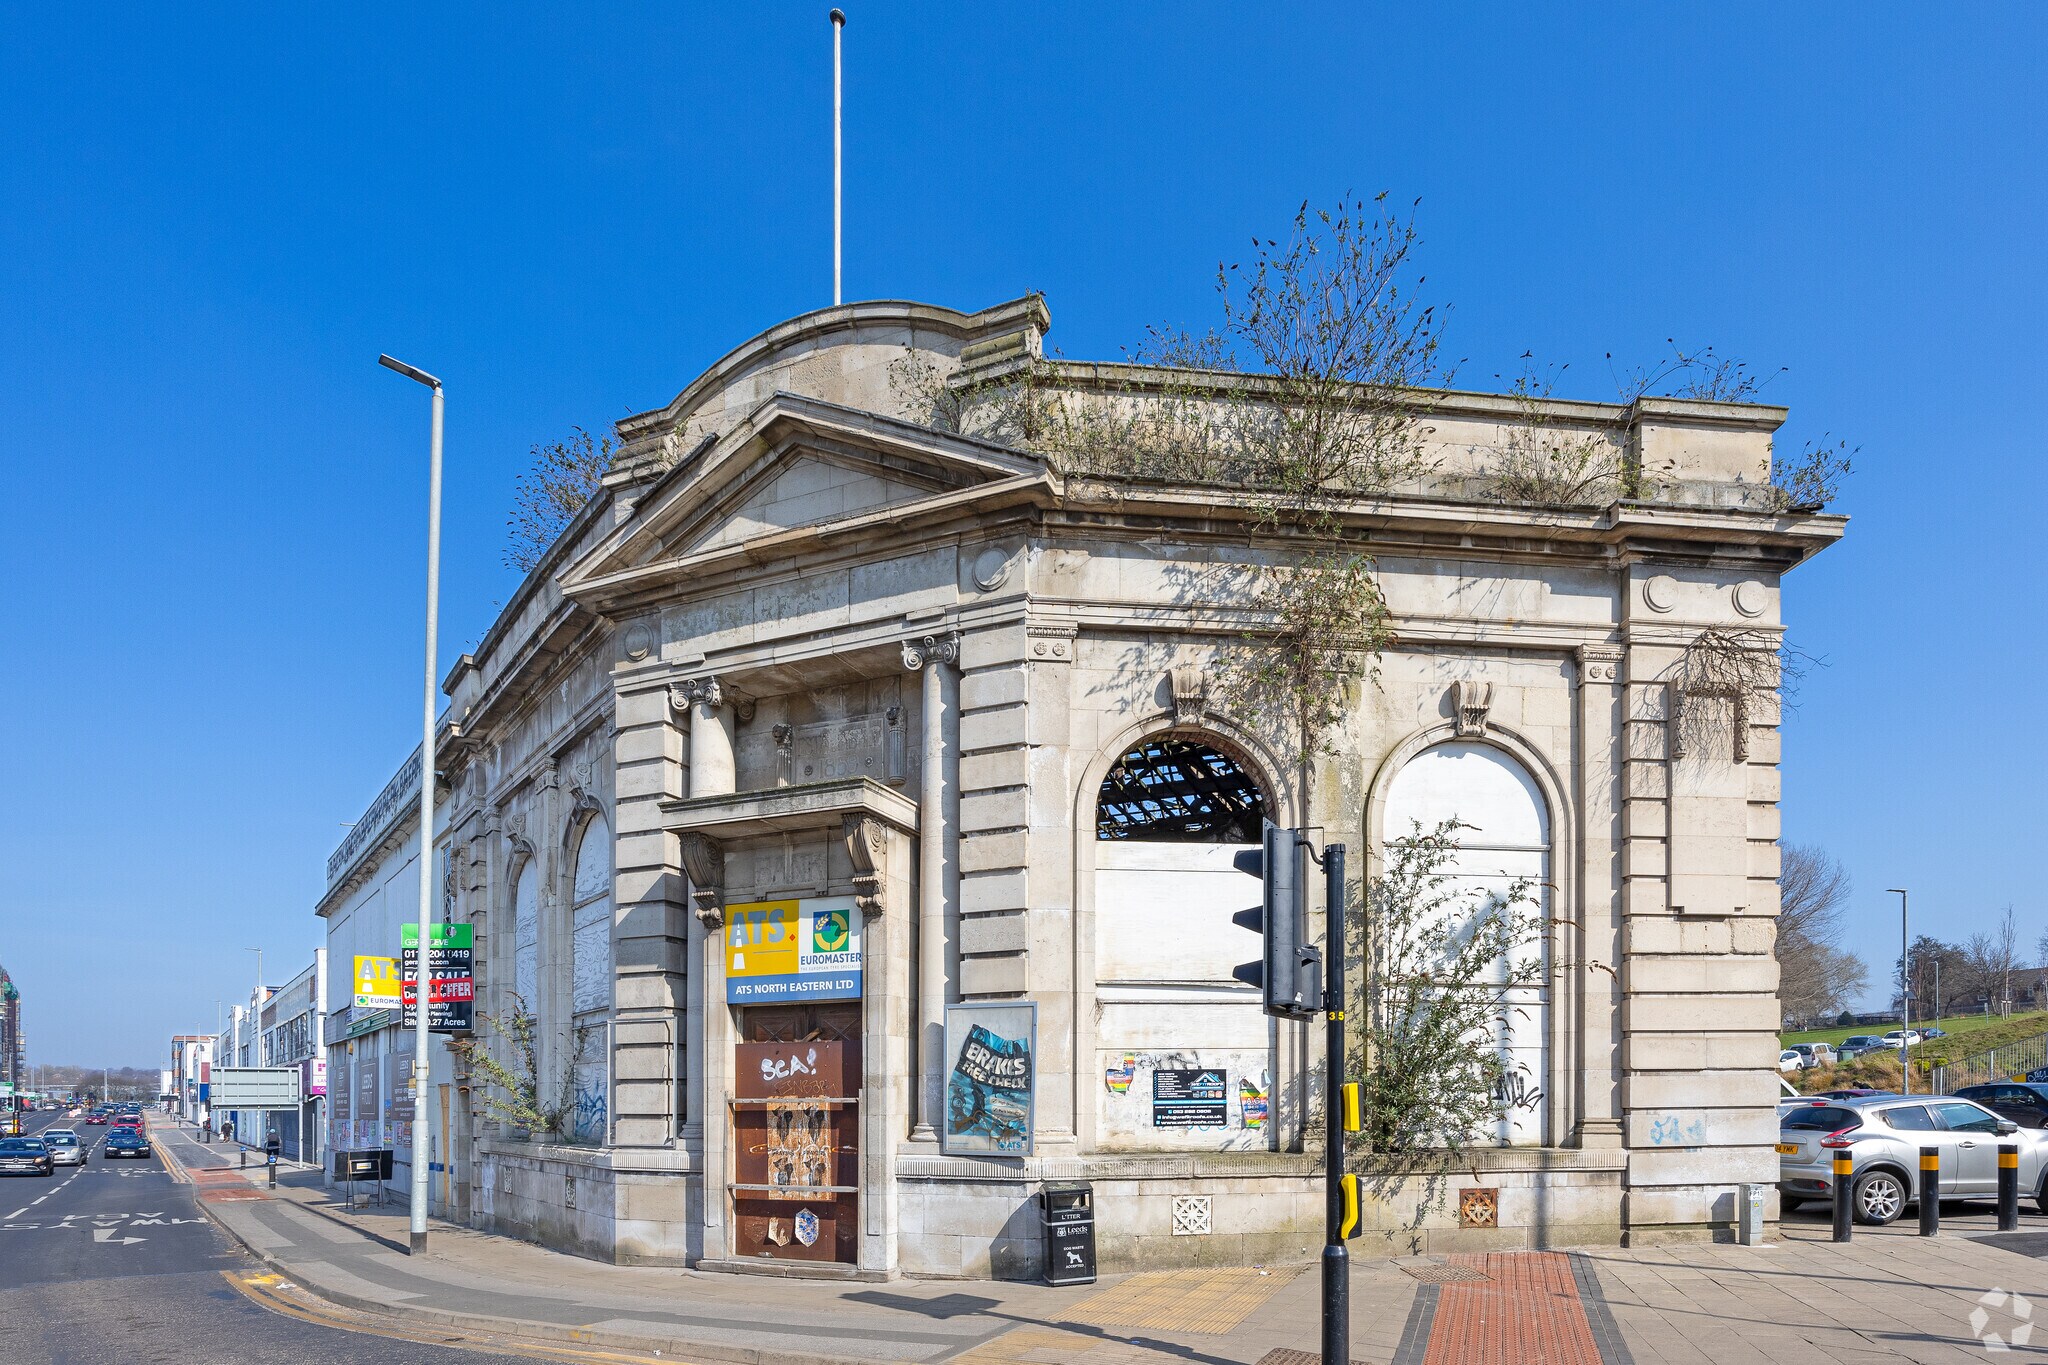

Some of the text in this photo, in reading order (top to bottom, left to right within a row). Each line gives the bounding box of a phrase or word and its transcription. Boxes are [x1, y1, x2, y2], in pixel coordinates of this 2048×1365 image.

[729, 908, 785, 946] ATS
[800, 952, 862, 966] EUROMASTER
[735, 979, 854, 995] ATS NORTH EASTERN LTD
[404, 1002, 450, 1010] Optunity
[1328, 1011, 1345, 1021] 35
[443, 1018, 466, 1026] Acres
[1006, 1141, 1021, 1149] ATS
